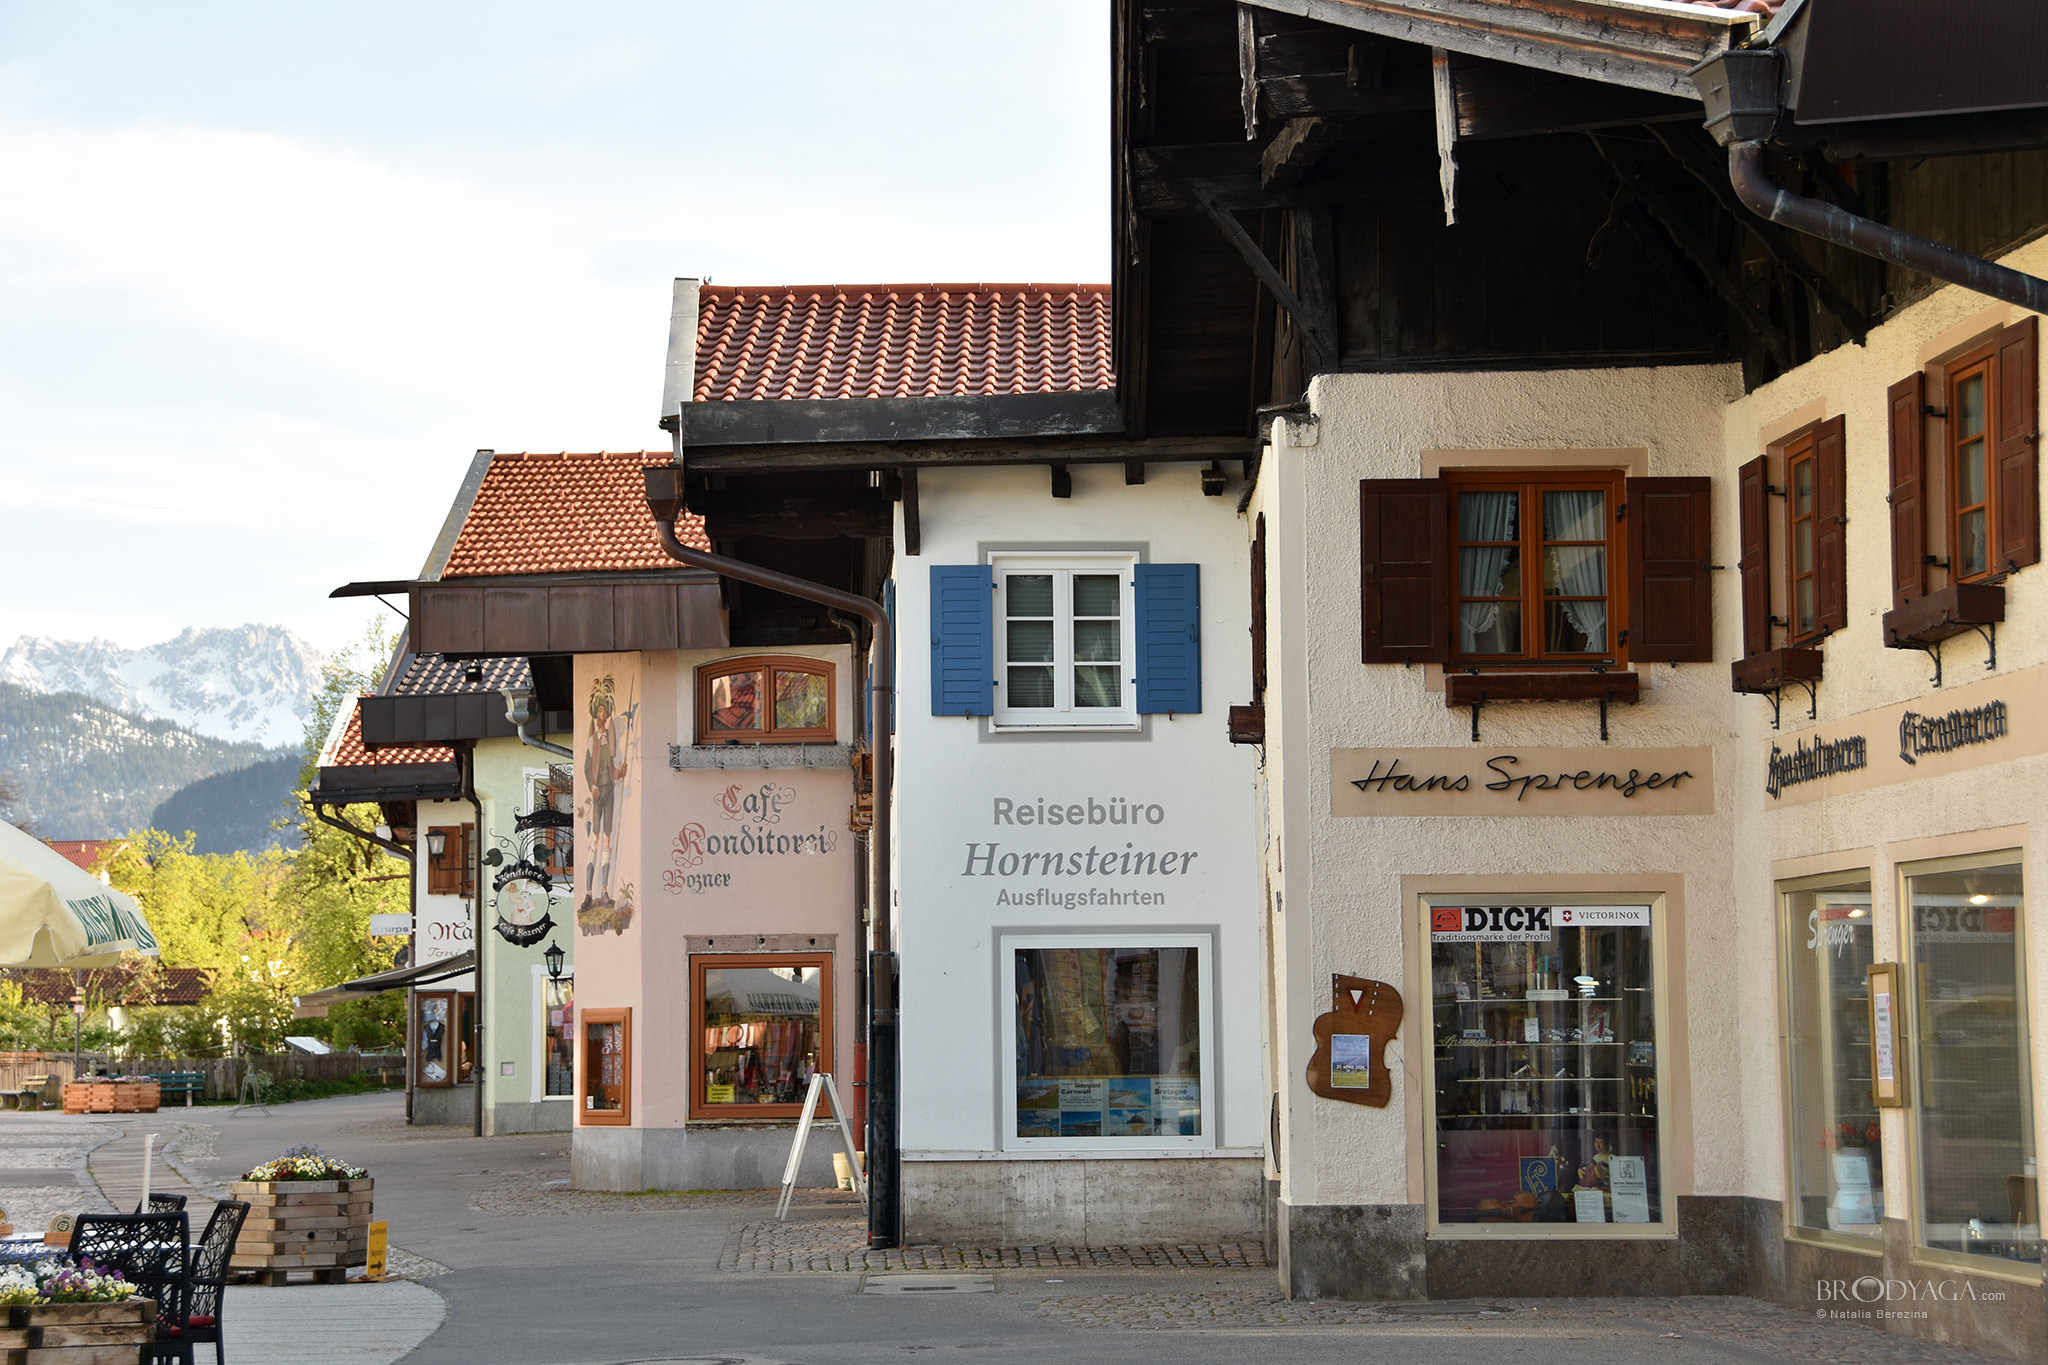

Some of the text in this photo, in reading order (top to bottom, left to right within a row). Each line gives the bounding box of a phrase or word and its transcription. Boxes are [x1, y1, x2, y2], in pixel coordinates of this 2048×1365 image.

[1899, 699, 2007, 765] Eisenwaren
[1350, 755, 1693, 801] Hans Sprenger
[714, 782, 796, 825] Café
[993, 797, 1165, 826] Reisebüro
[671, 822, 838, 869] Konditorei
[961, 842, 1199, 877] Hornsteiner
[662, 869, 731, 895] Bozner
[996, 888, 1165, 910] Ausflugsfahrten
[1465, 907, 1550, 931] DICK
[1579, 911, 1640, 920] VICTORINOX
[374, 925, 409, 934] nirps
[1432, 933, 1550, 941] Traditionsmarke der Profis
[1154, 1088, 1188, 1096] Bretagne
